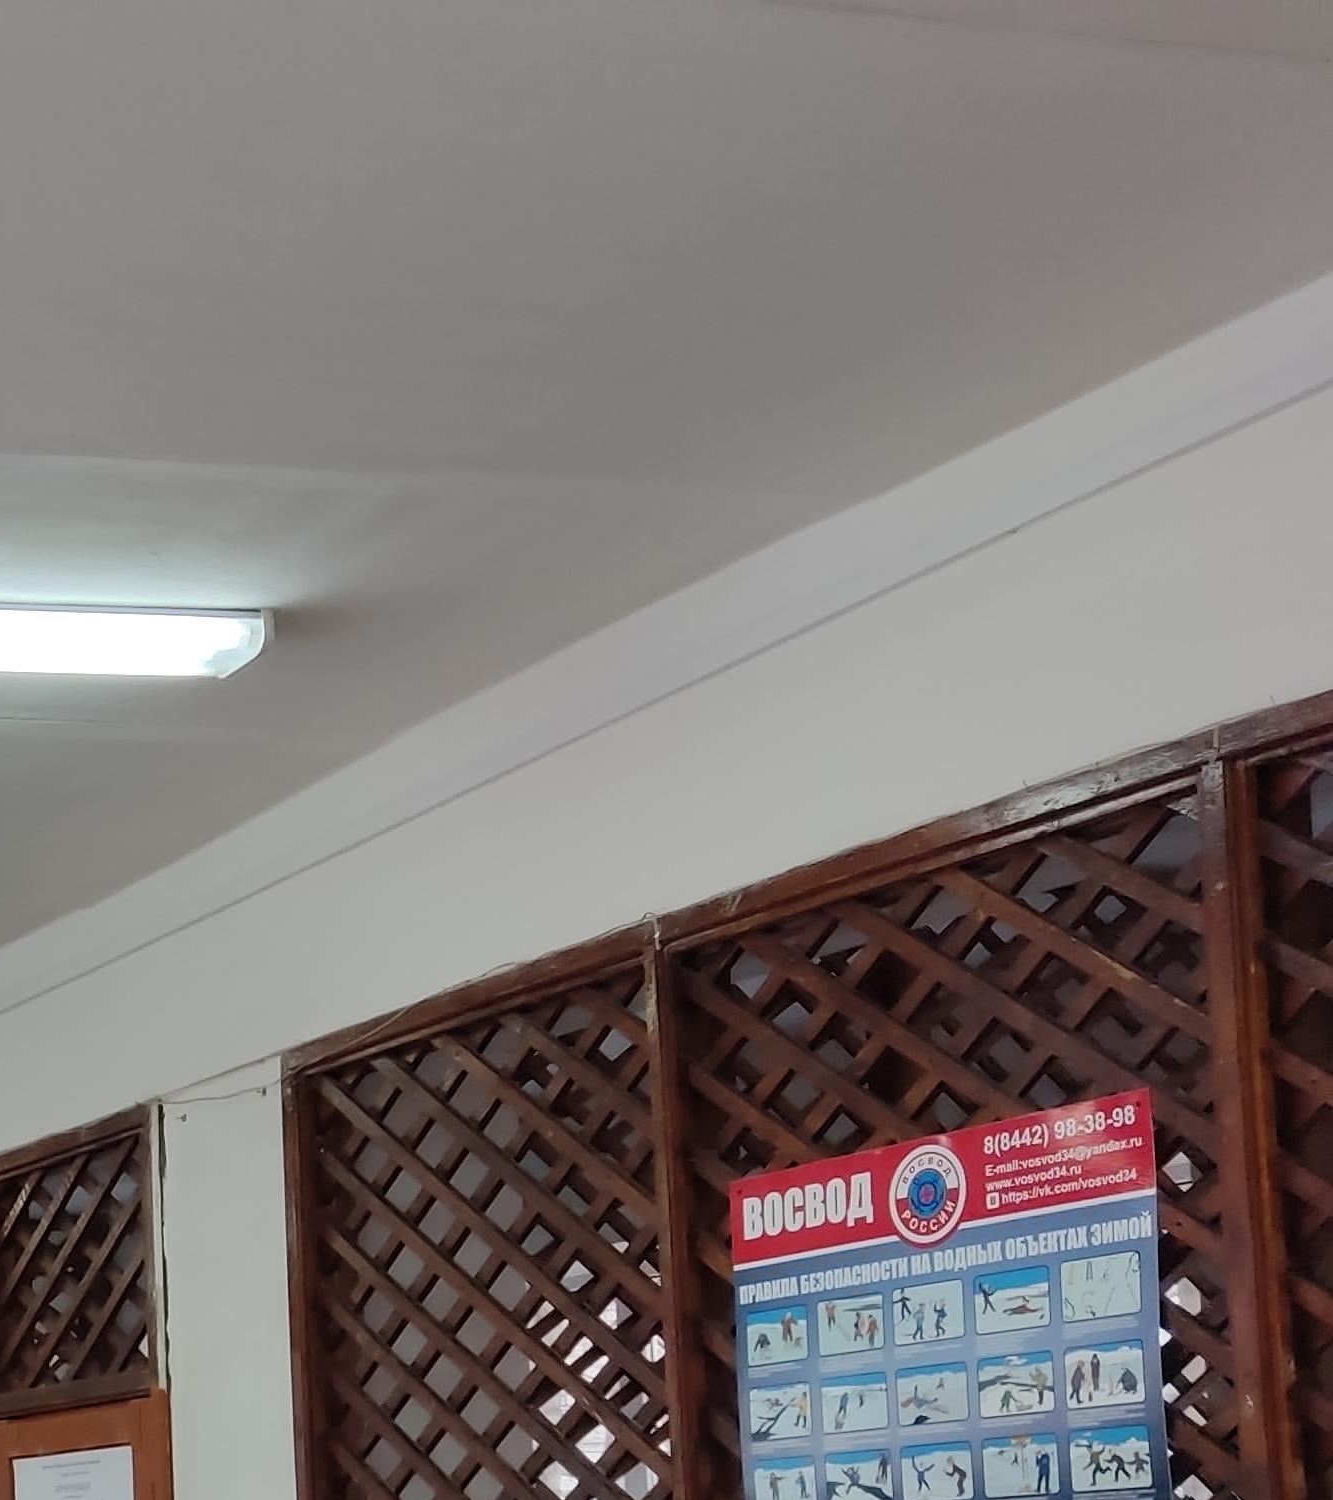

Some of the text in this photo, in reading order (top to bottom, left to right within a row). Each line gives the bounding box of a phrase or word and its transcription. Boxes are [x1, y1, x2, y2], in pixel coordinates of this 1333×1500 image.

[983, 1104, 1136, 1158] 8(8442) 98-38-98
[985, 1164, 1083, 1192] www.vosvod34.ru
[1001, 1167, 1138, 1205] https://vk.com/vosvod34
[742, 1172, 874, 1241] ВОСВОД
[900, 1200, 956, 1233] РОССИИ
[739, 1210, 1153, 1306] ПРАВИЛА БЕЗОПАСНОСТИ НА ВОДНЫХ ОБЪЕКТАХ ЗИМОЙ
